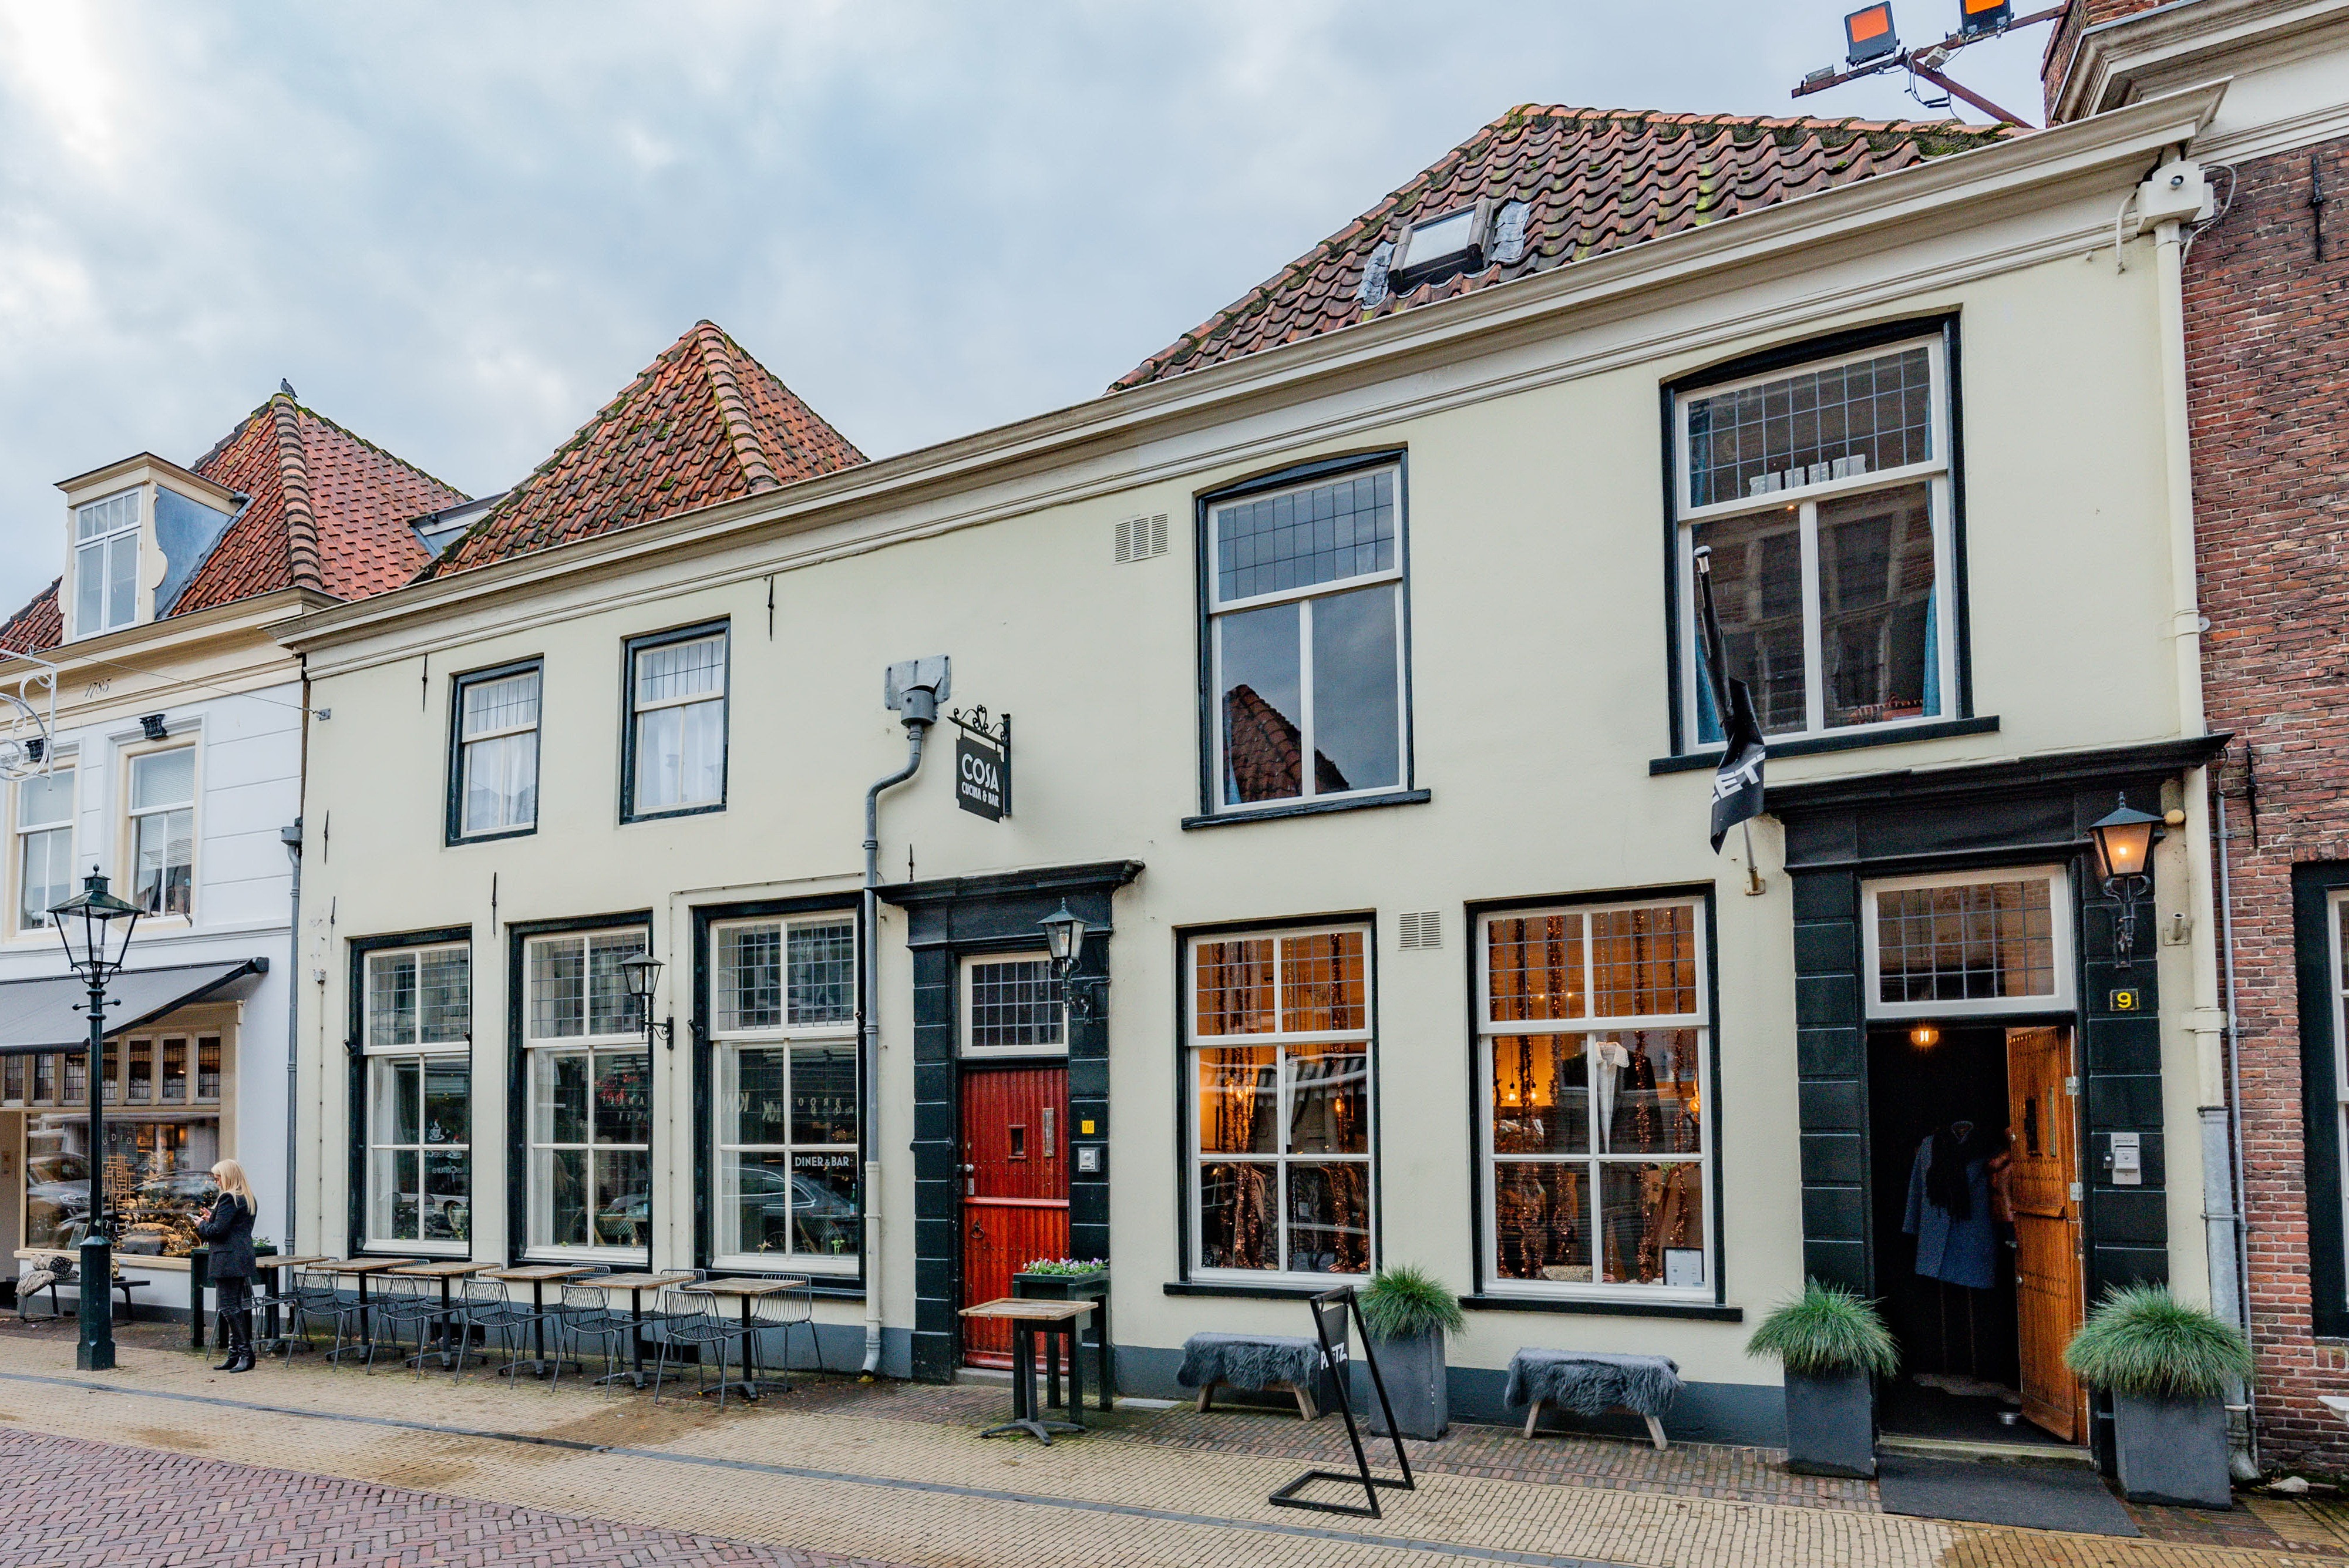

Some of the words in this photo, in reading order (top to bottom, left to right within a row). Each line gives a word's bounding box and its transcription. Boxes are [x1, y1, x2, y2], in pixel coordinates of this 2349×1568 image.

[85, 678, 112, 698] 1785
[962, 753, 999, 792] COSA
[962, 782, 981, 800] CUCINA
[982, 790, 987, 803] &
[988, 792, 999, 807] BAR
[2117, 992, 2131, 1008] 9
[795, 1156, 823, 1166] DINER
[831, 1156, 850, 1166] BAR
[1321, 1342, 1348, 1370] PTZ
